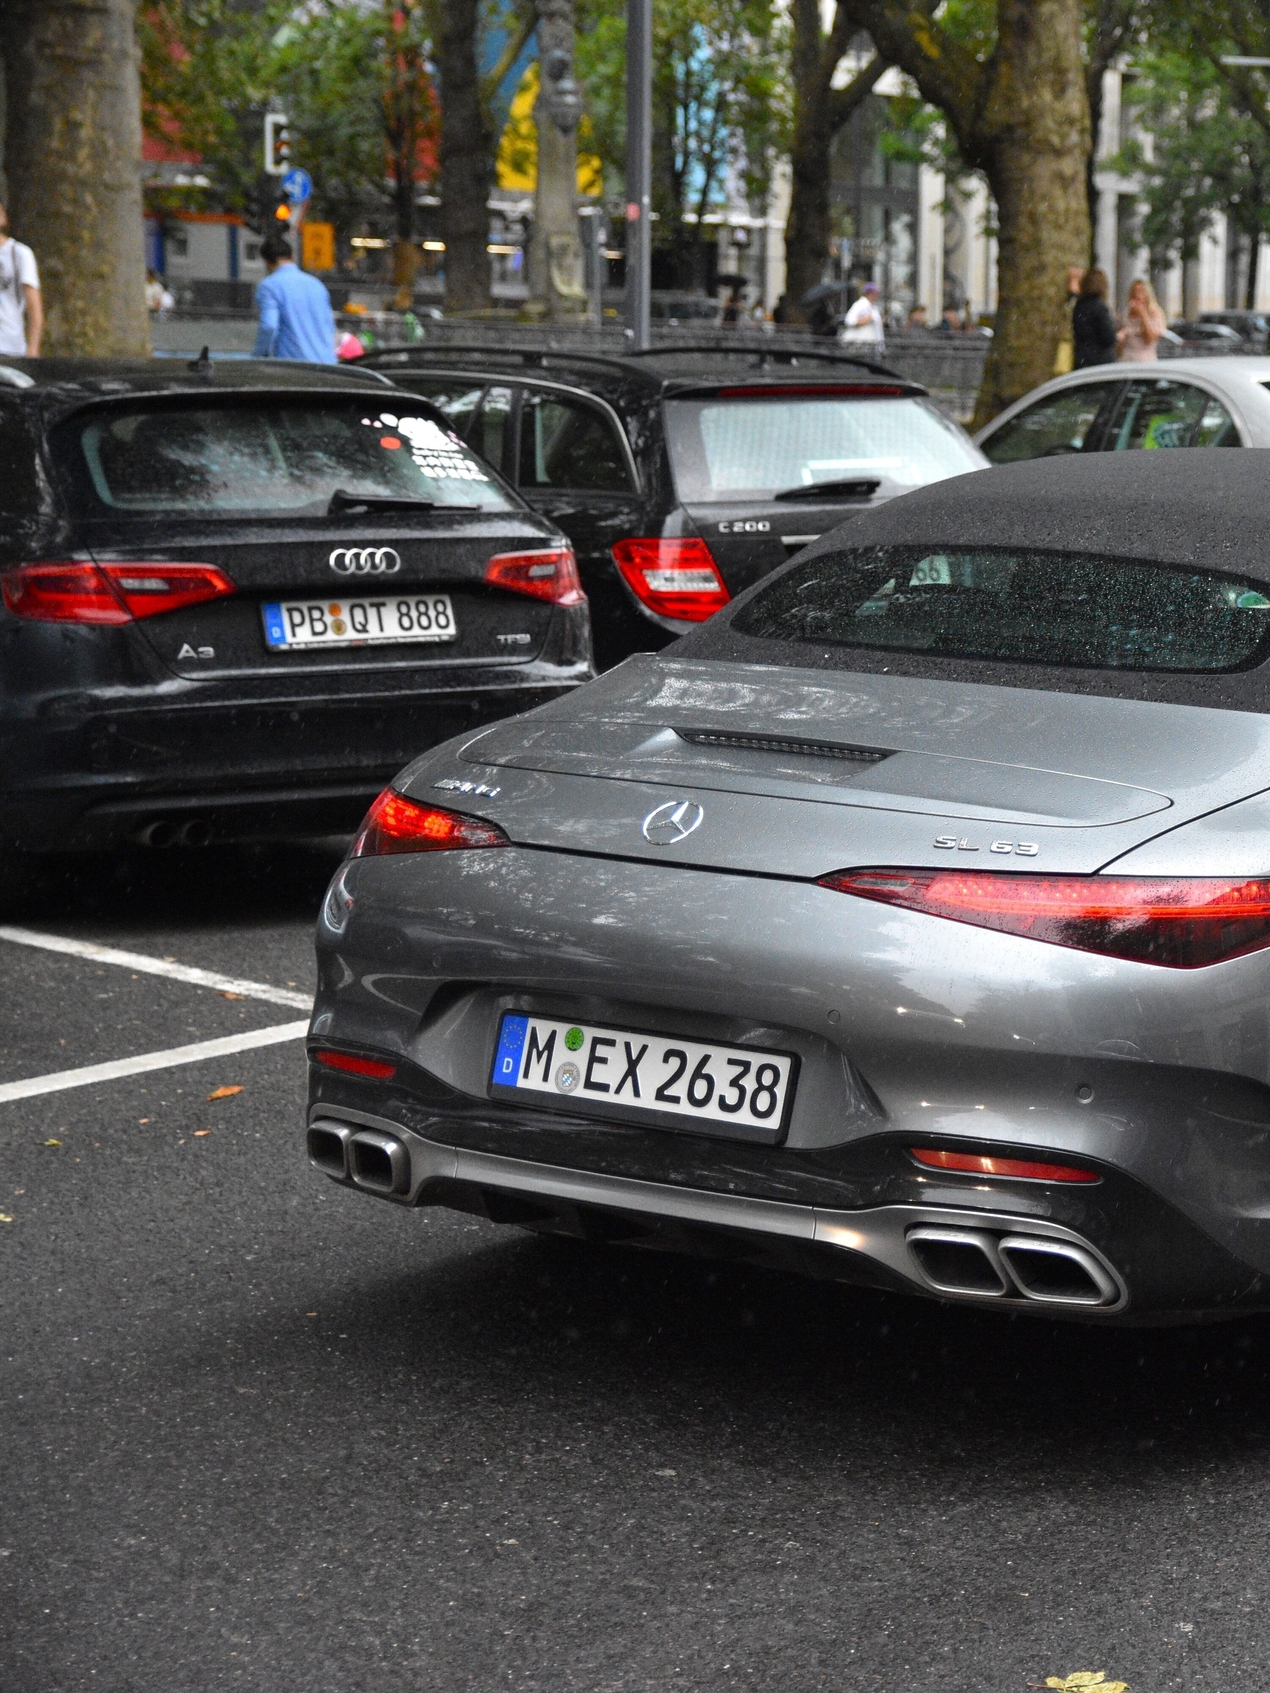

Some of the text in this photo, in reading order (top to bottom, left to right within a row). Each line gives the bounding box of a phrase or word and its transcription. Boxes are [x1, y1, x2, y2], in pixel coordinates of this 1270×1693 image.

[718, 520, 771, 533] C 200
[286, 599, 450, 638] PB QT 888
[177, 642, 215, 661] A3
[933, 835, 1040, 857] SL 63
[502, 1057, 513, 1074] D
[522, 1026, 558, 1083] M
[583, 1036, 650, 1099] EX
[654, 1048, 781, 1119] 2638
